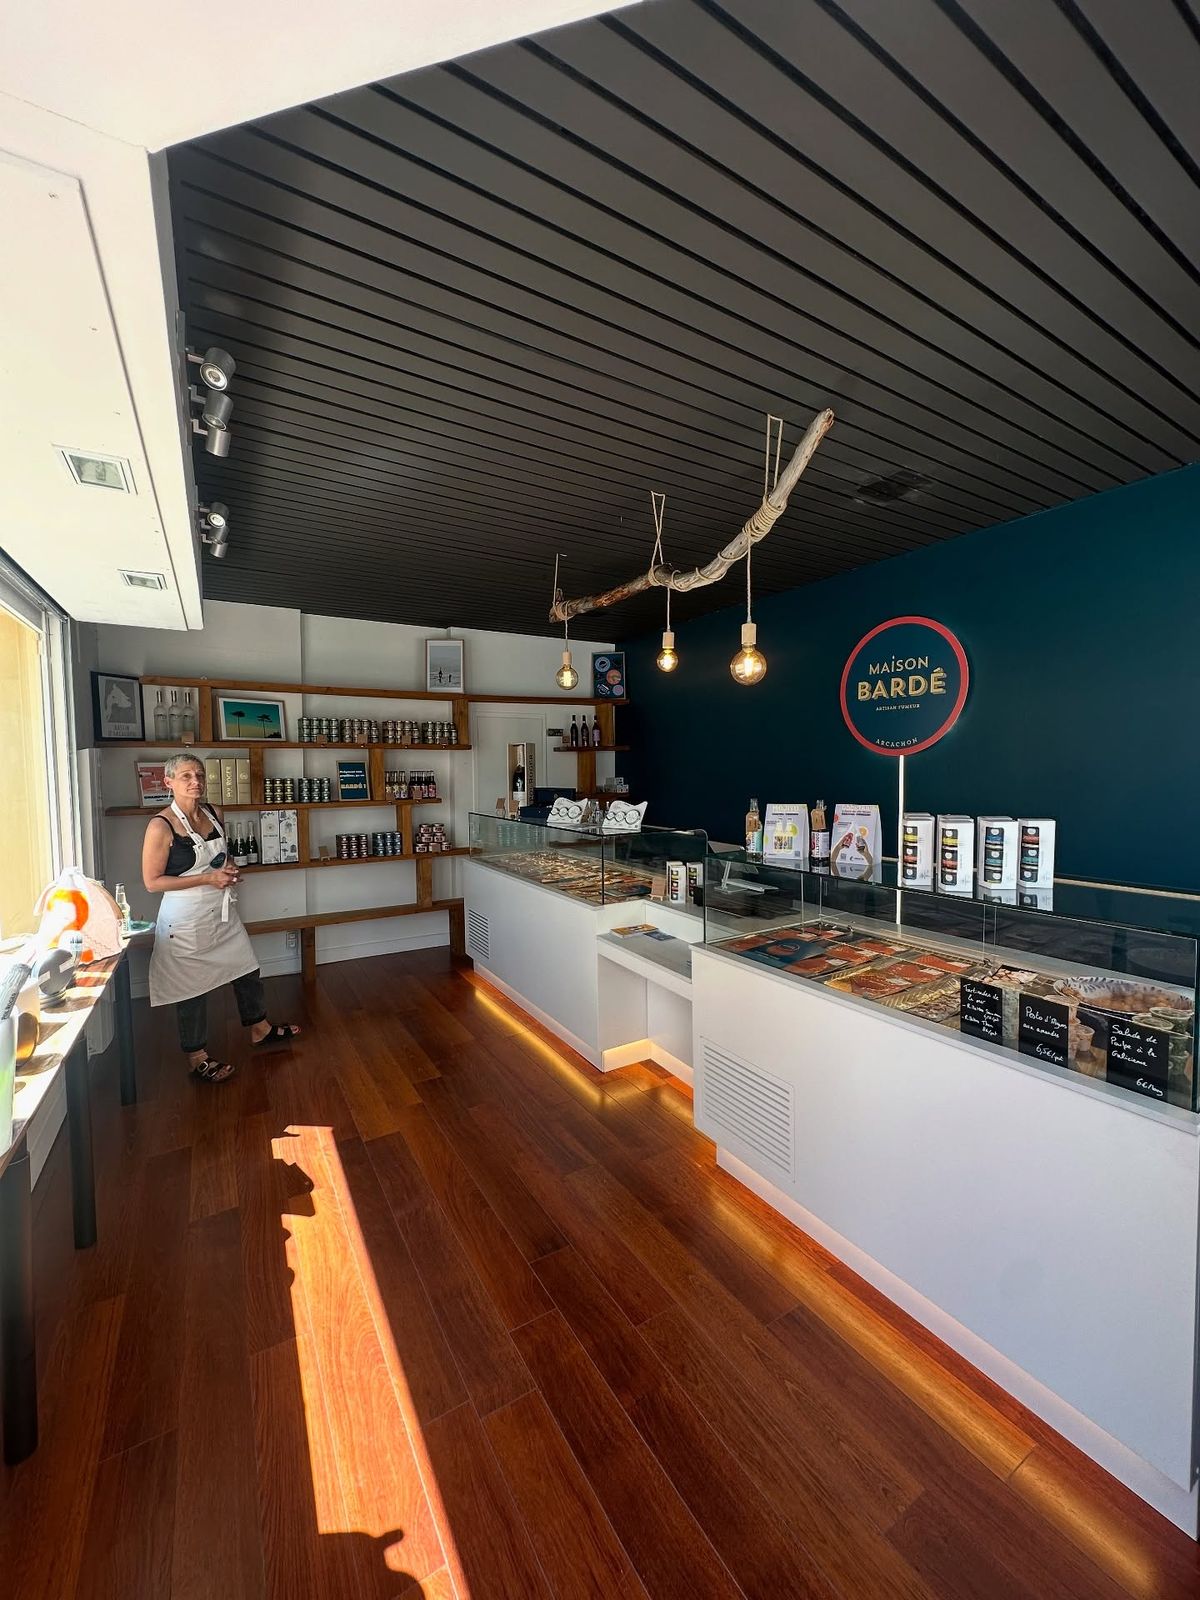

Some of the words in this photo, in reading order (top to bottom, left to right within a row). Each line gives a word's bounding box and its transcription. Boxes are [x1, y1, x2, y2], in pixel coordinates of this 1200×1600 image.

[857, 667, 947, 701] BARDÉ
[875, 704, 897, 712] ARTISAN
[875, 737, 918, 748] ARCACHON
[1112, 1024, 1141, 1040] Salade
[1146, 1035, 1158, 1045] de
[1136, 1046, 1143, 1054] à
[1147, 1047, 1158, 1058] la
